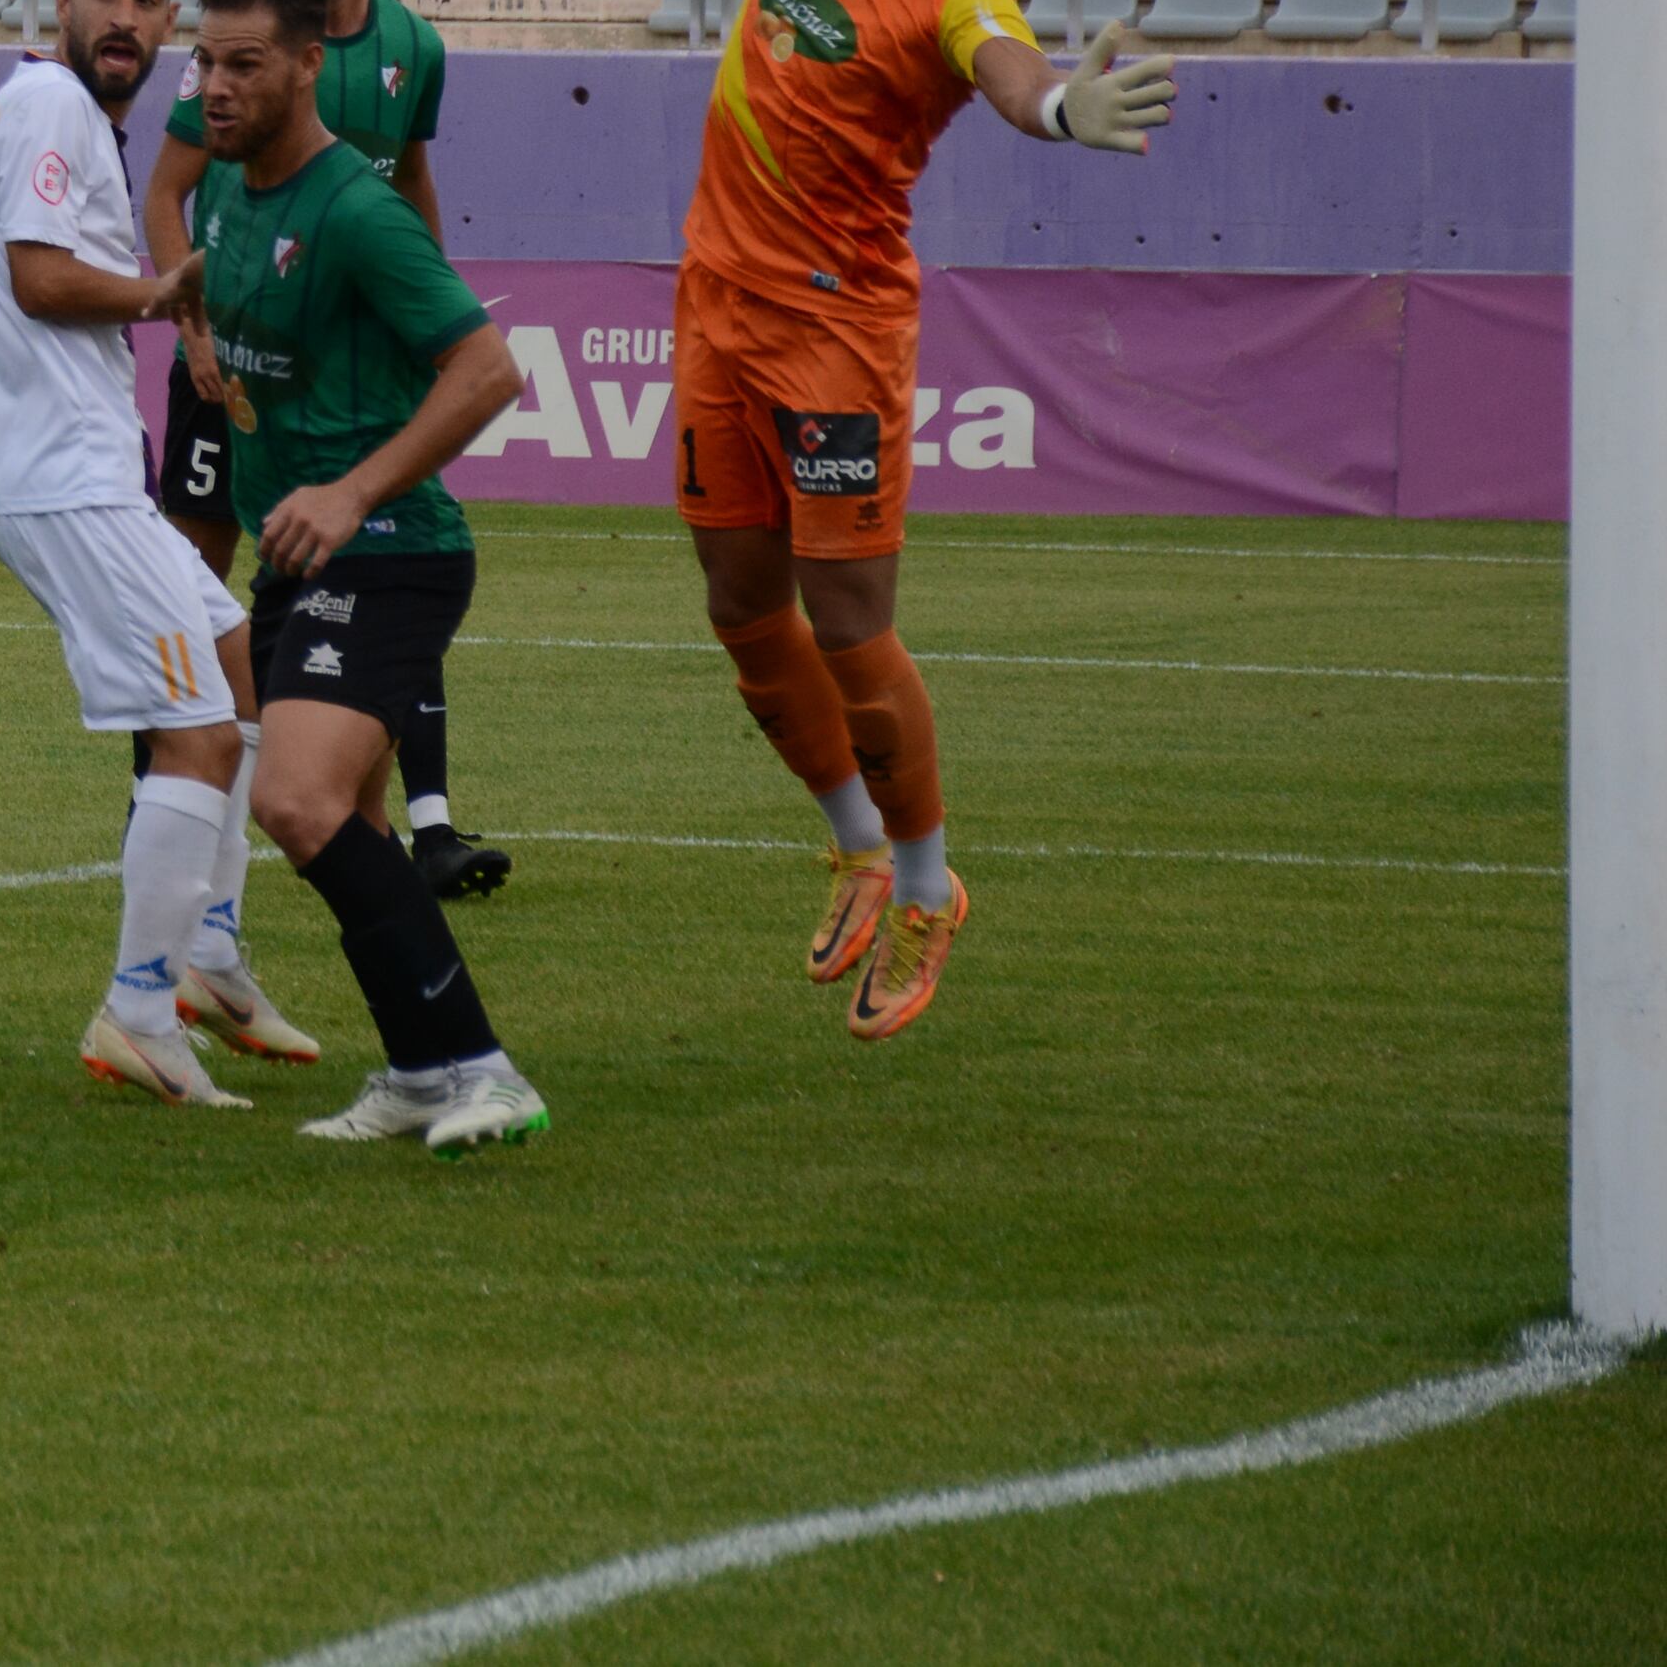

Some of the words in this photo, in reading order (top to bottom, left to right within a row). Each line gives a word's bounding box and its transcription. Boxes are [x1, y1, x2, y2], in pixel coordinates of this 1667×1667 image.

[582, 326, 675, 366] GRUP
[461, 324, 1037, 471] Avza
[186, 437, 222, 497] 5
[682, 427, 708, 498] 1
[794, 456, 877, 481] CURRO
[155, 630, 199, 703] 11
